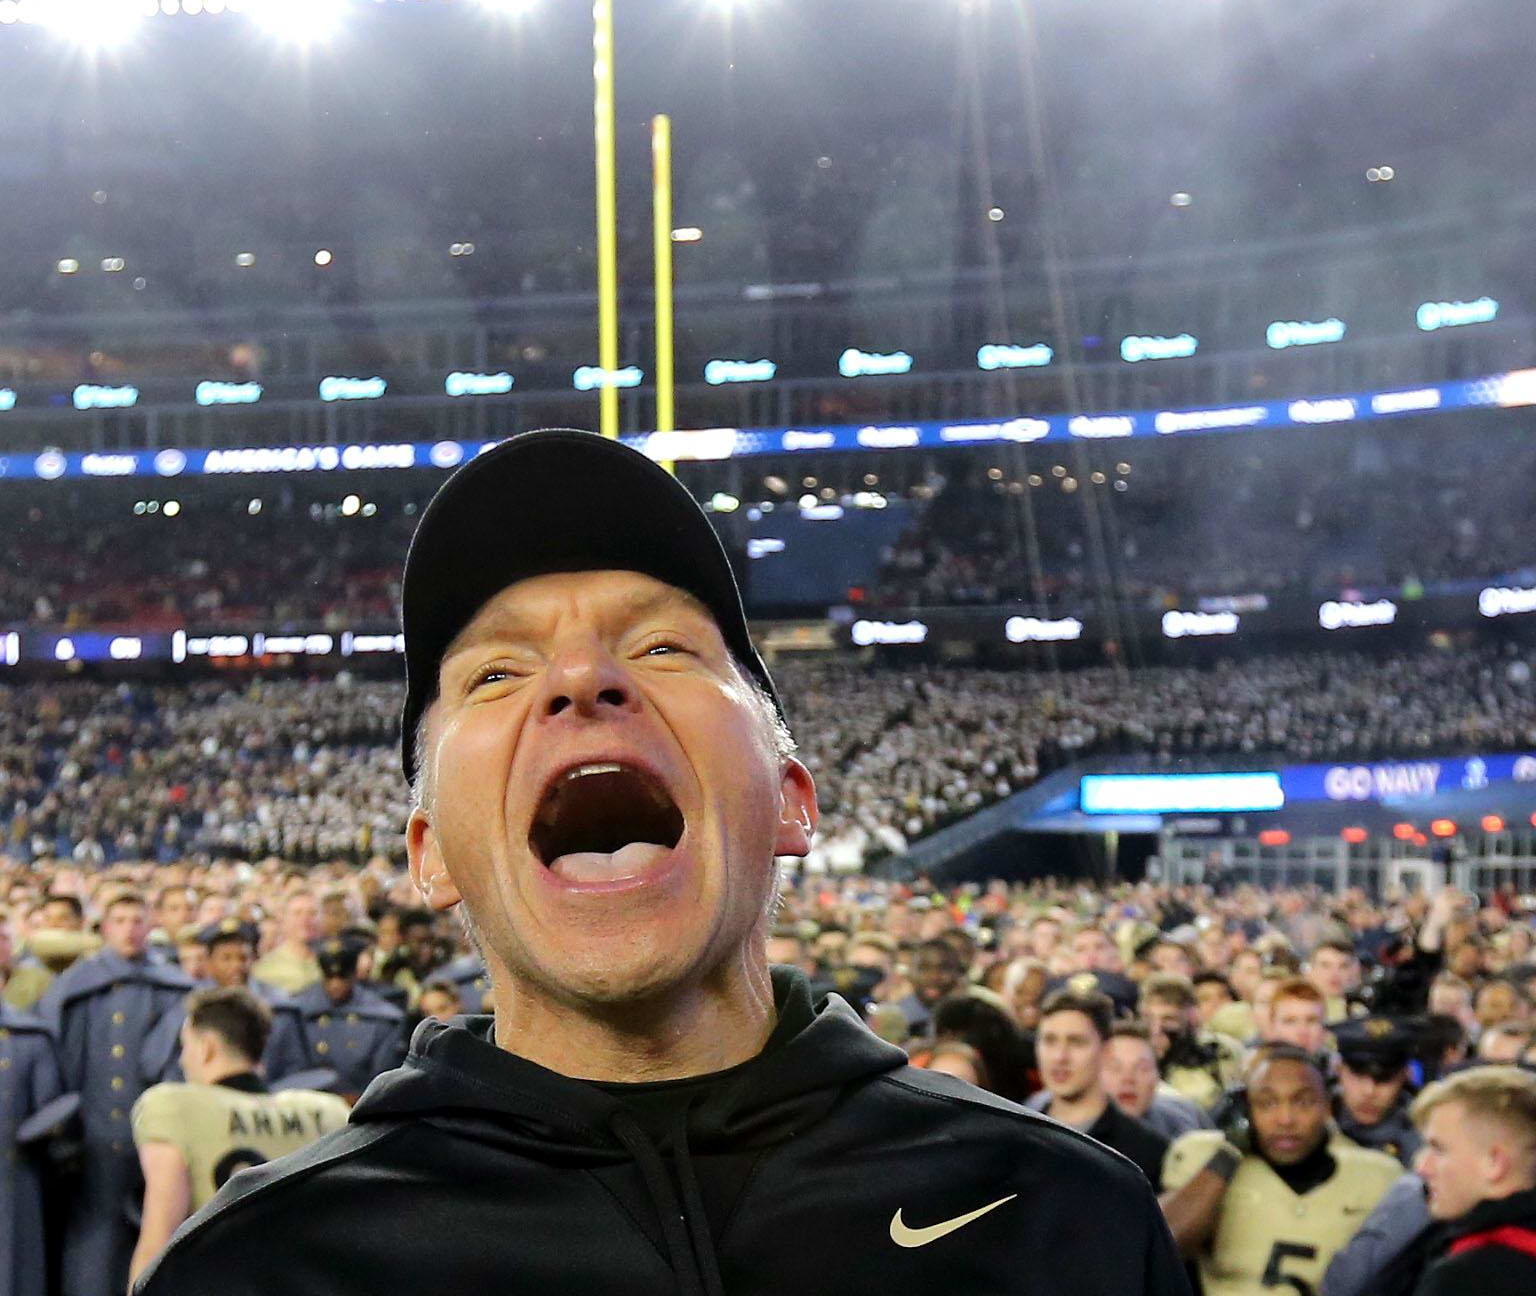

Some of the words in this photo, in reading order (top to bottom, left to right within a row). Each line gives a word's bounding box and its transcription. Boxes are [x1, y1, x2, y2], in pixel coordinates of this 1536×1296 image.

[1324, 765, 1371, 801] GO
[1372, 762, 1441, 797] NAVY
[227, 1109, 324, 1139] ARMY
